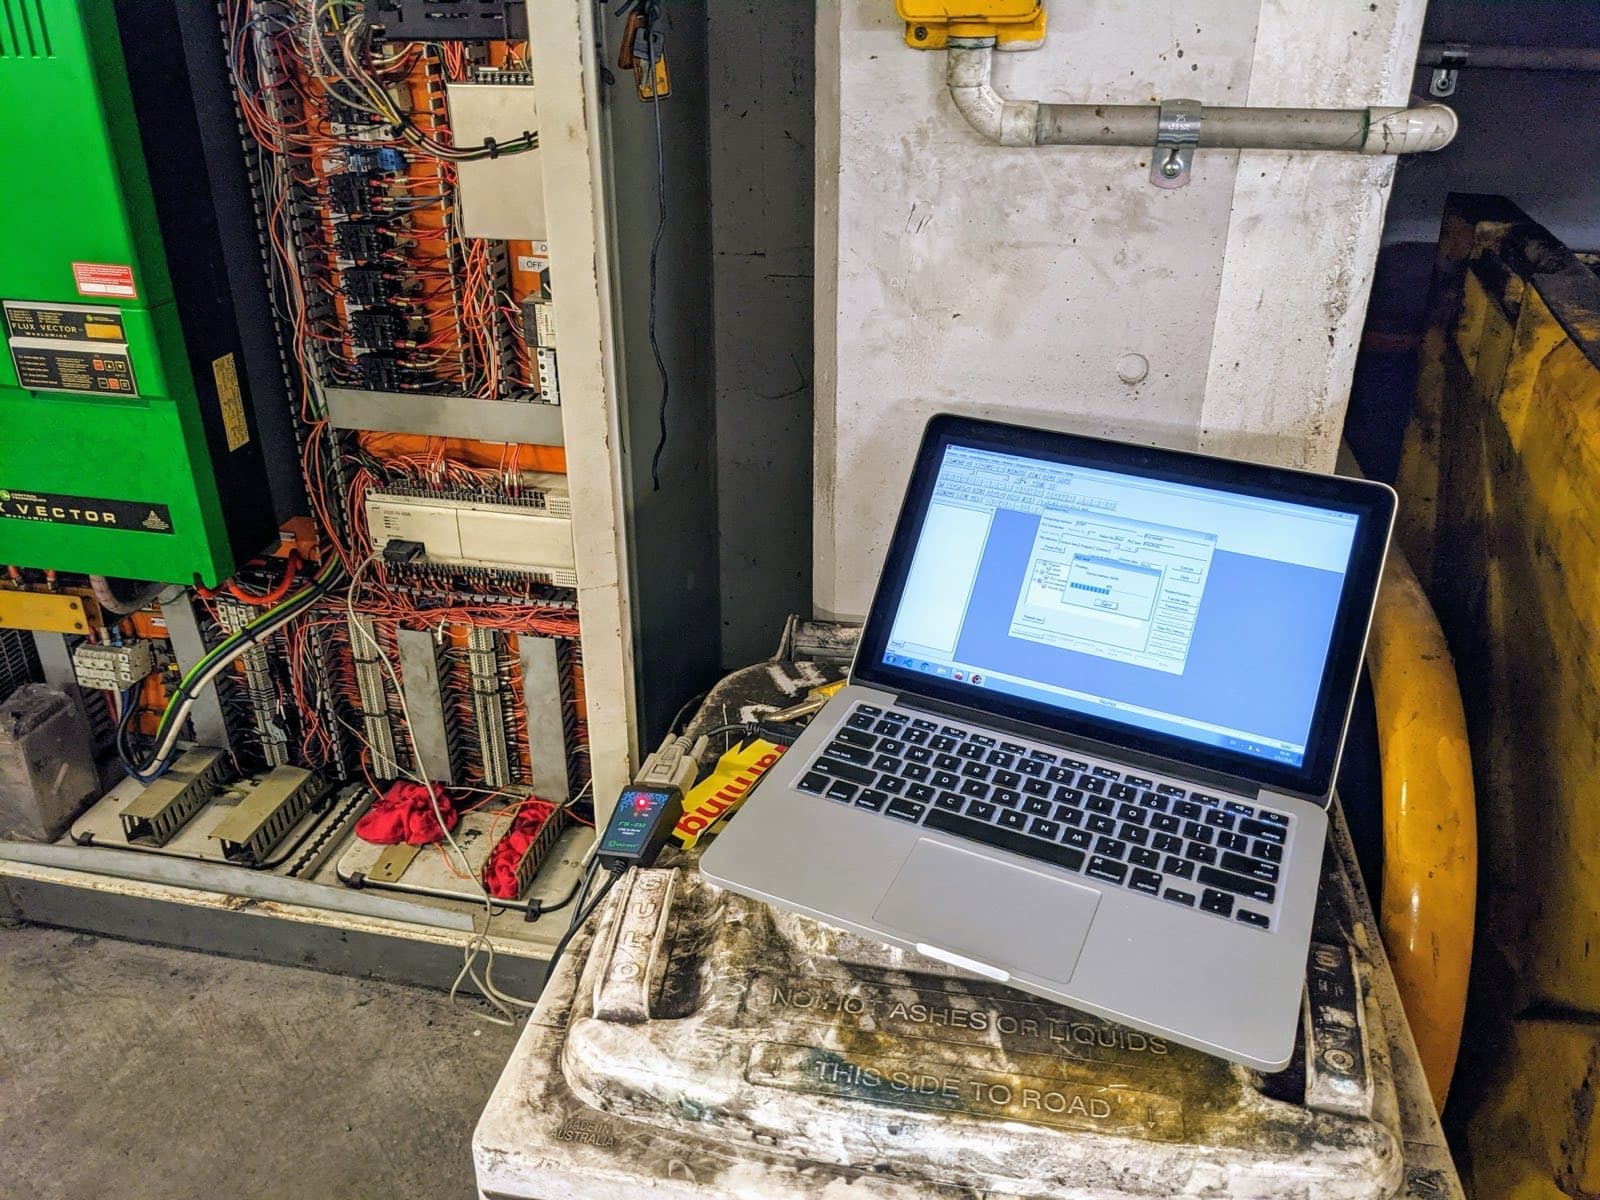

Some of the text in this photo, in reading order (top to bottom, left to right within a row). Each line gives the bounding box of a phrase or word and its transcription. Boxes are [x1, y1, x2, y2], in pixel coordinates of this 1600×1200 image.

[526, 260, 543, 268] OFF
[12, 322, 78, 333] FLUX VECTOR
[16, 503, 117, 524] VECTOR
[771, 986, 815, 1009] NO
[889, 1001, 988, 1030] ASHES
[996, 1016, 1039, 1038] OR
[1048, 1020, 1168, 1055] LIQUIDS
[816, 1060, 1111, 1119] THIS SIDE TO ROAD
[561, 1118, 613, 1134] MADE IN
[550, 1126, 615, 1148] AUSTRALIA
